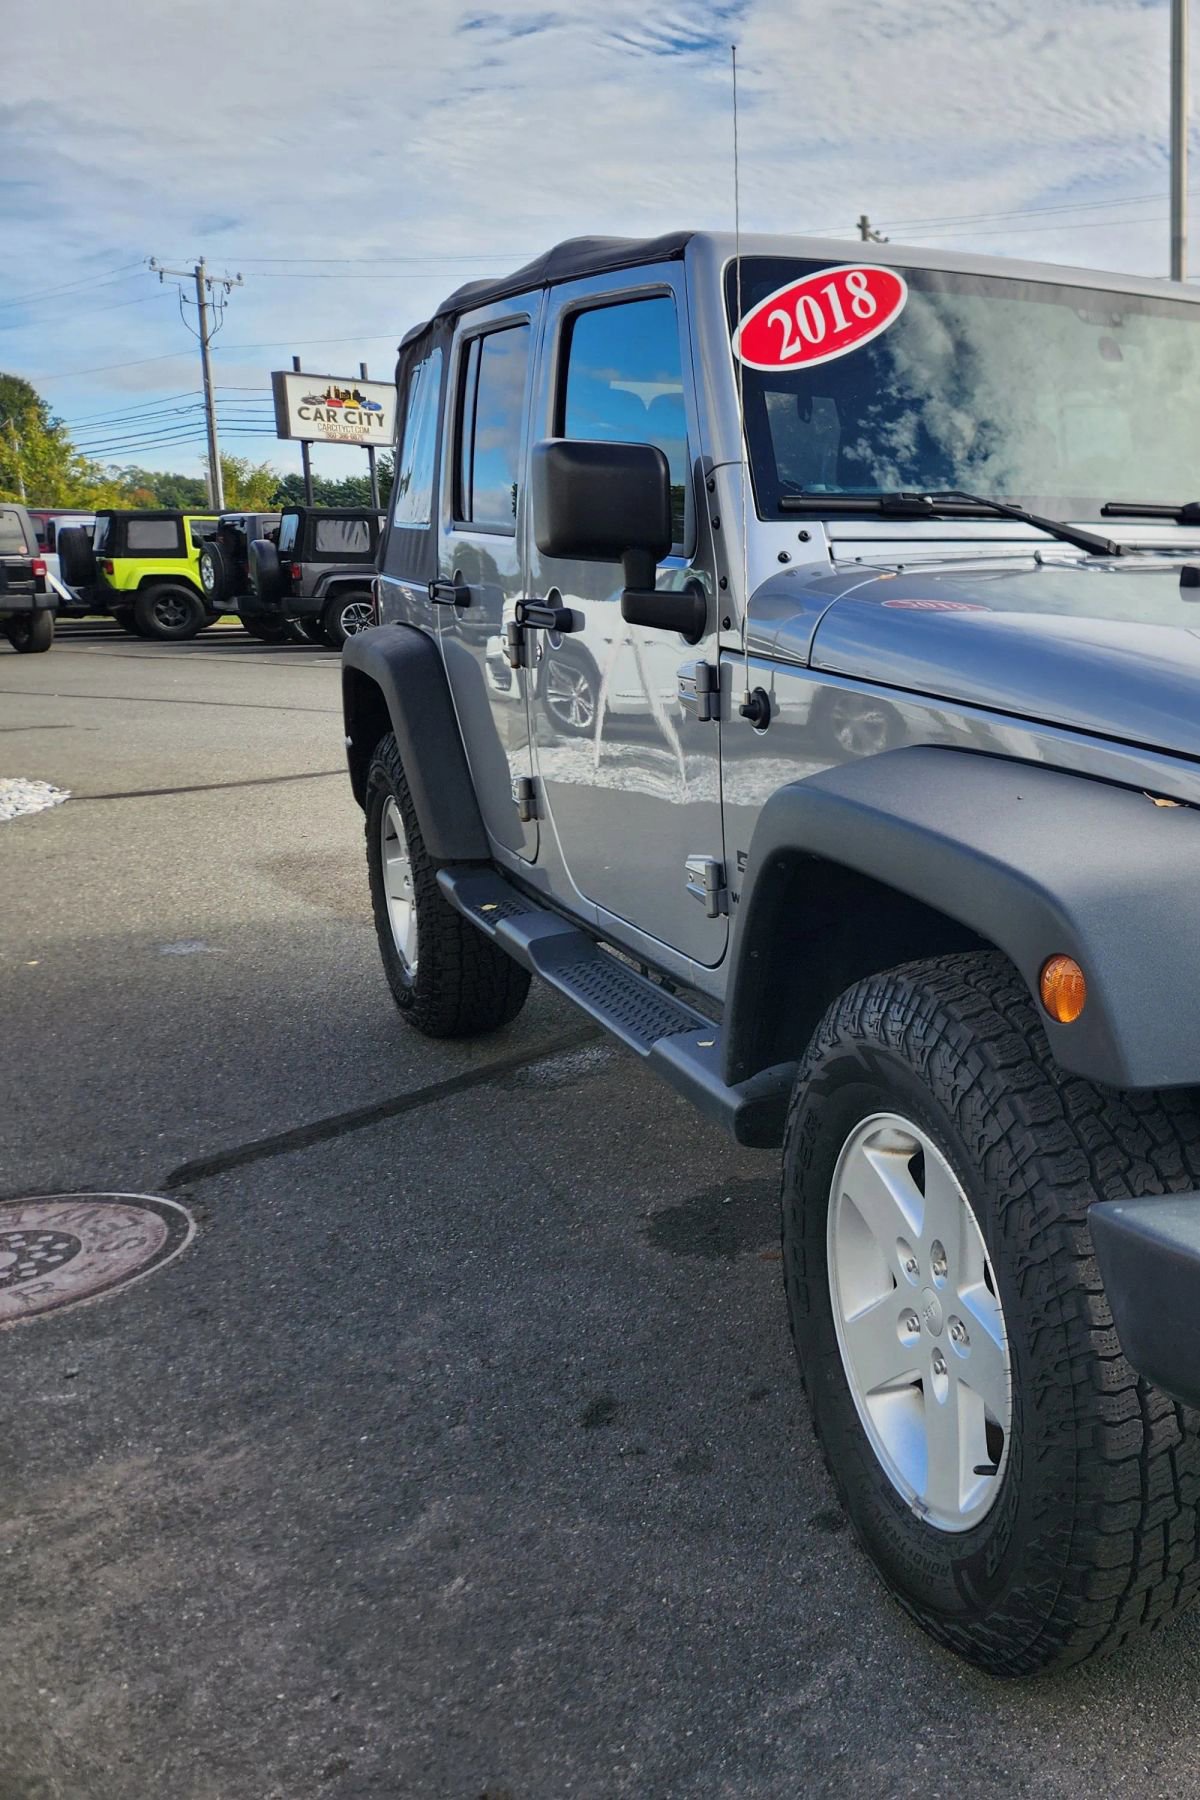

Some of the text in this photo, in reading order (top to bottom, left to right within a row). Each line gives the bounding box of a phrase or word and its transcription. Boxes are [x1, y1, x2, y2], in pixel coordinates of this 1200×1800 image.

[767, 271, 877, 361] 2018
[297, 406, 385, 427] CAR CITY
